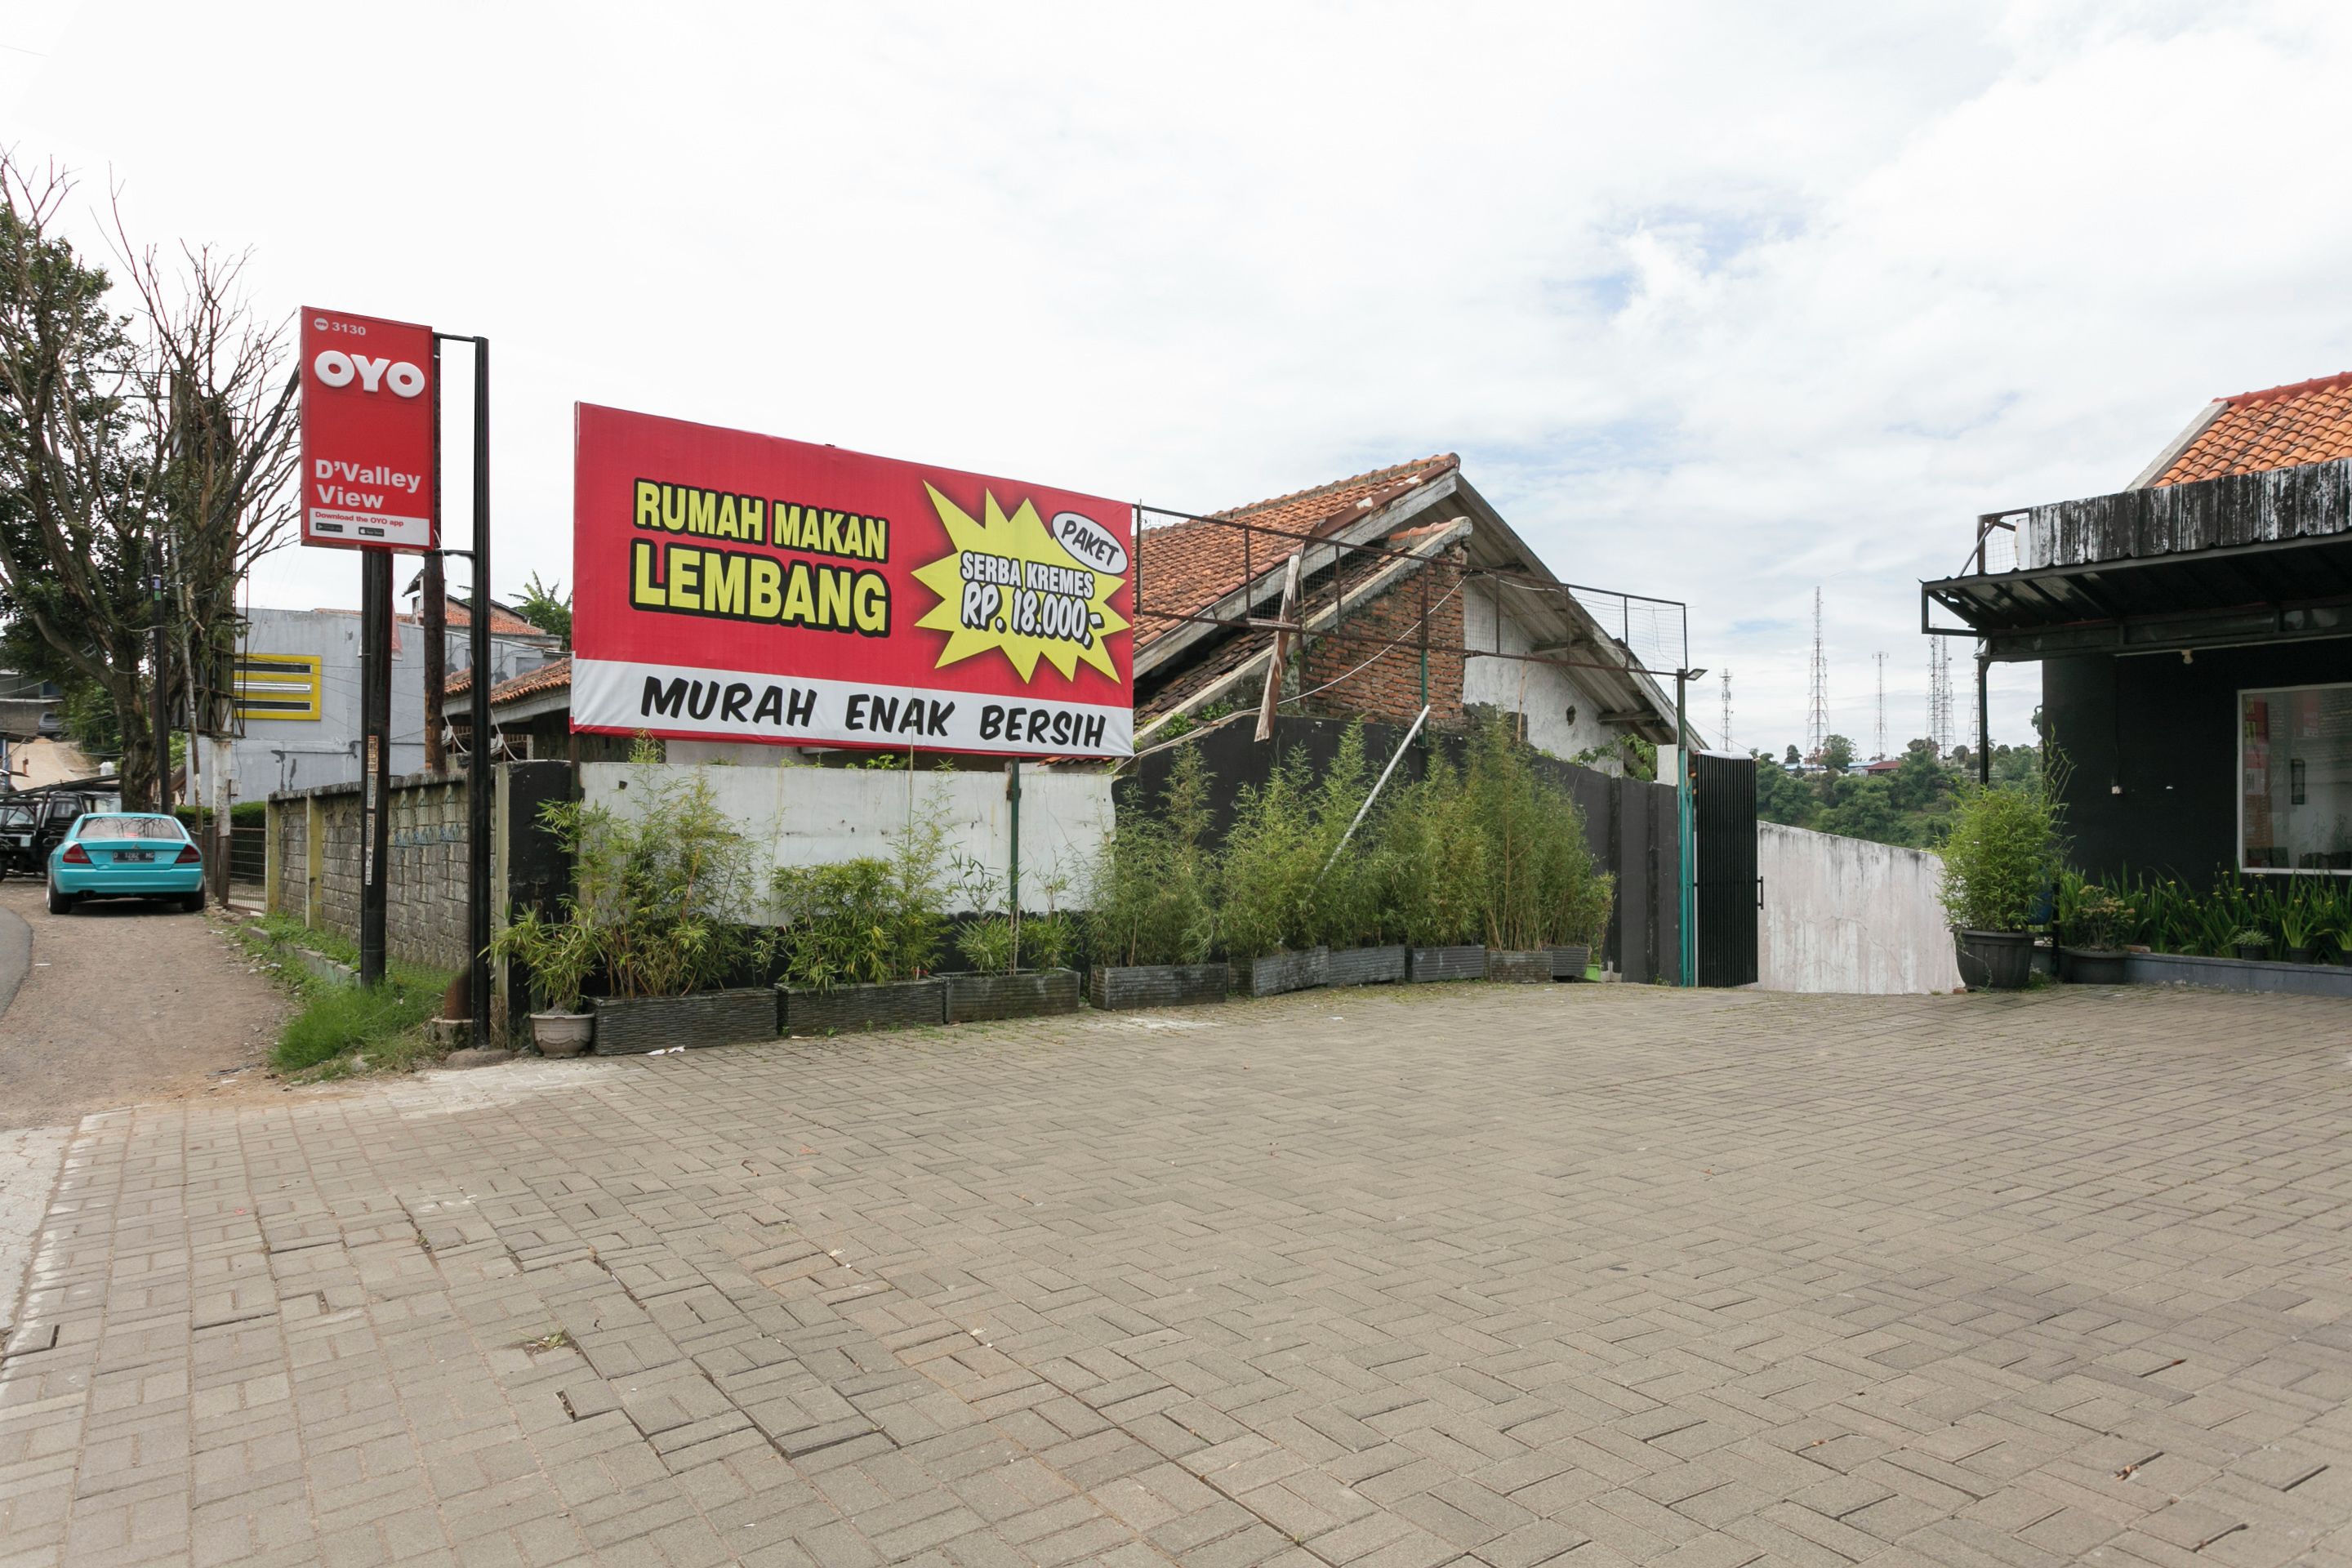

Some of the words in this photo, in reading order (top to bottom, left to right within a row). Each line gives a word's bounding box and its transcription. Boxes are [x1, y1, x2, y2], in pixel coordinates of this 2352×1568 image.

[332, 323, 366, 336] 3130
[314, 350, 425, 398] OYO
[315, 511, 354, 521] Download
[317, 484, 384, 509] View
[635, 479, 766, 544] RUMAH
[773, 501, 889, 562] MAKAN
[1062, 520, 1119, 566] PAKET
[630, 539, 890, 636] LEMBANG
[960, 550, 1022, 587] SERBA
[1026, 560, 1094, 599] KREMES
[961, 581, 1006, 633] RP.
[640, 676, 817, 728] MURAH
[844, 694, 956, 737] ENAK
[979, 704, 1107, 748] BERSIH
